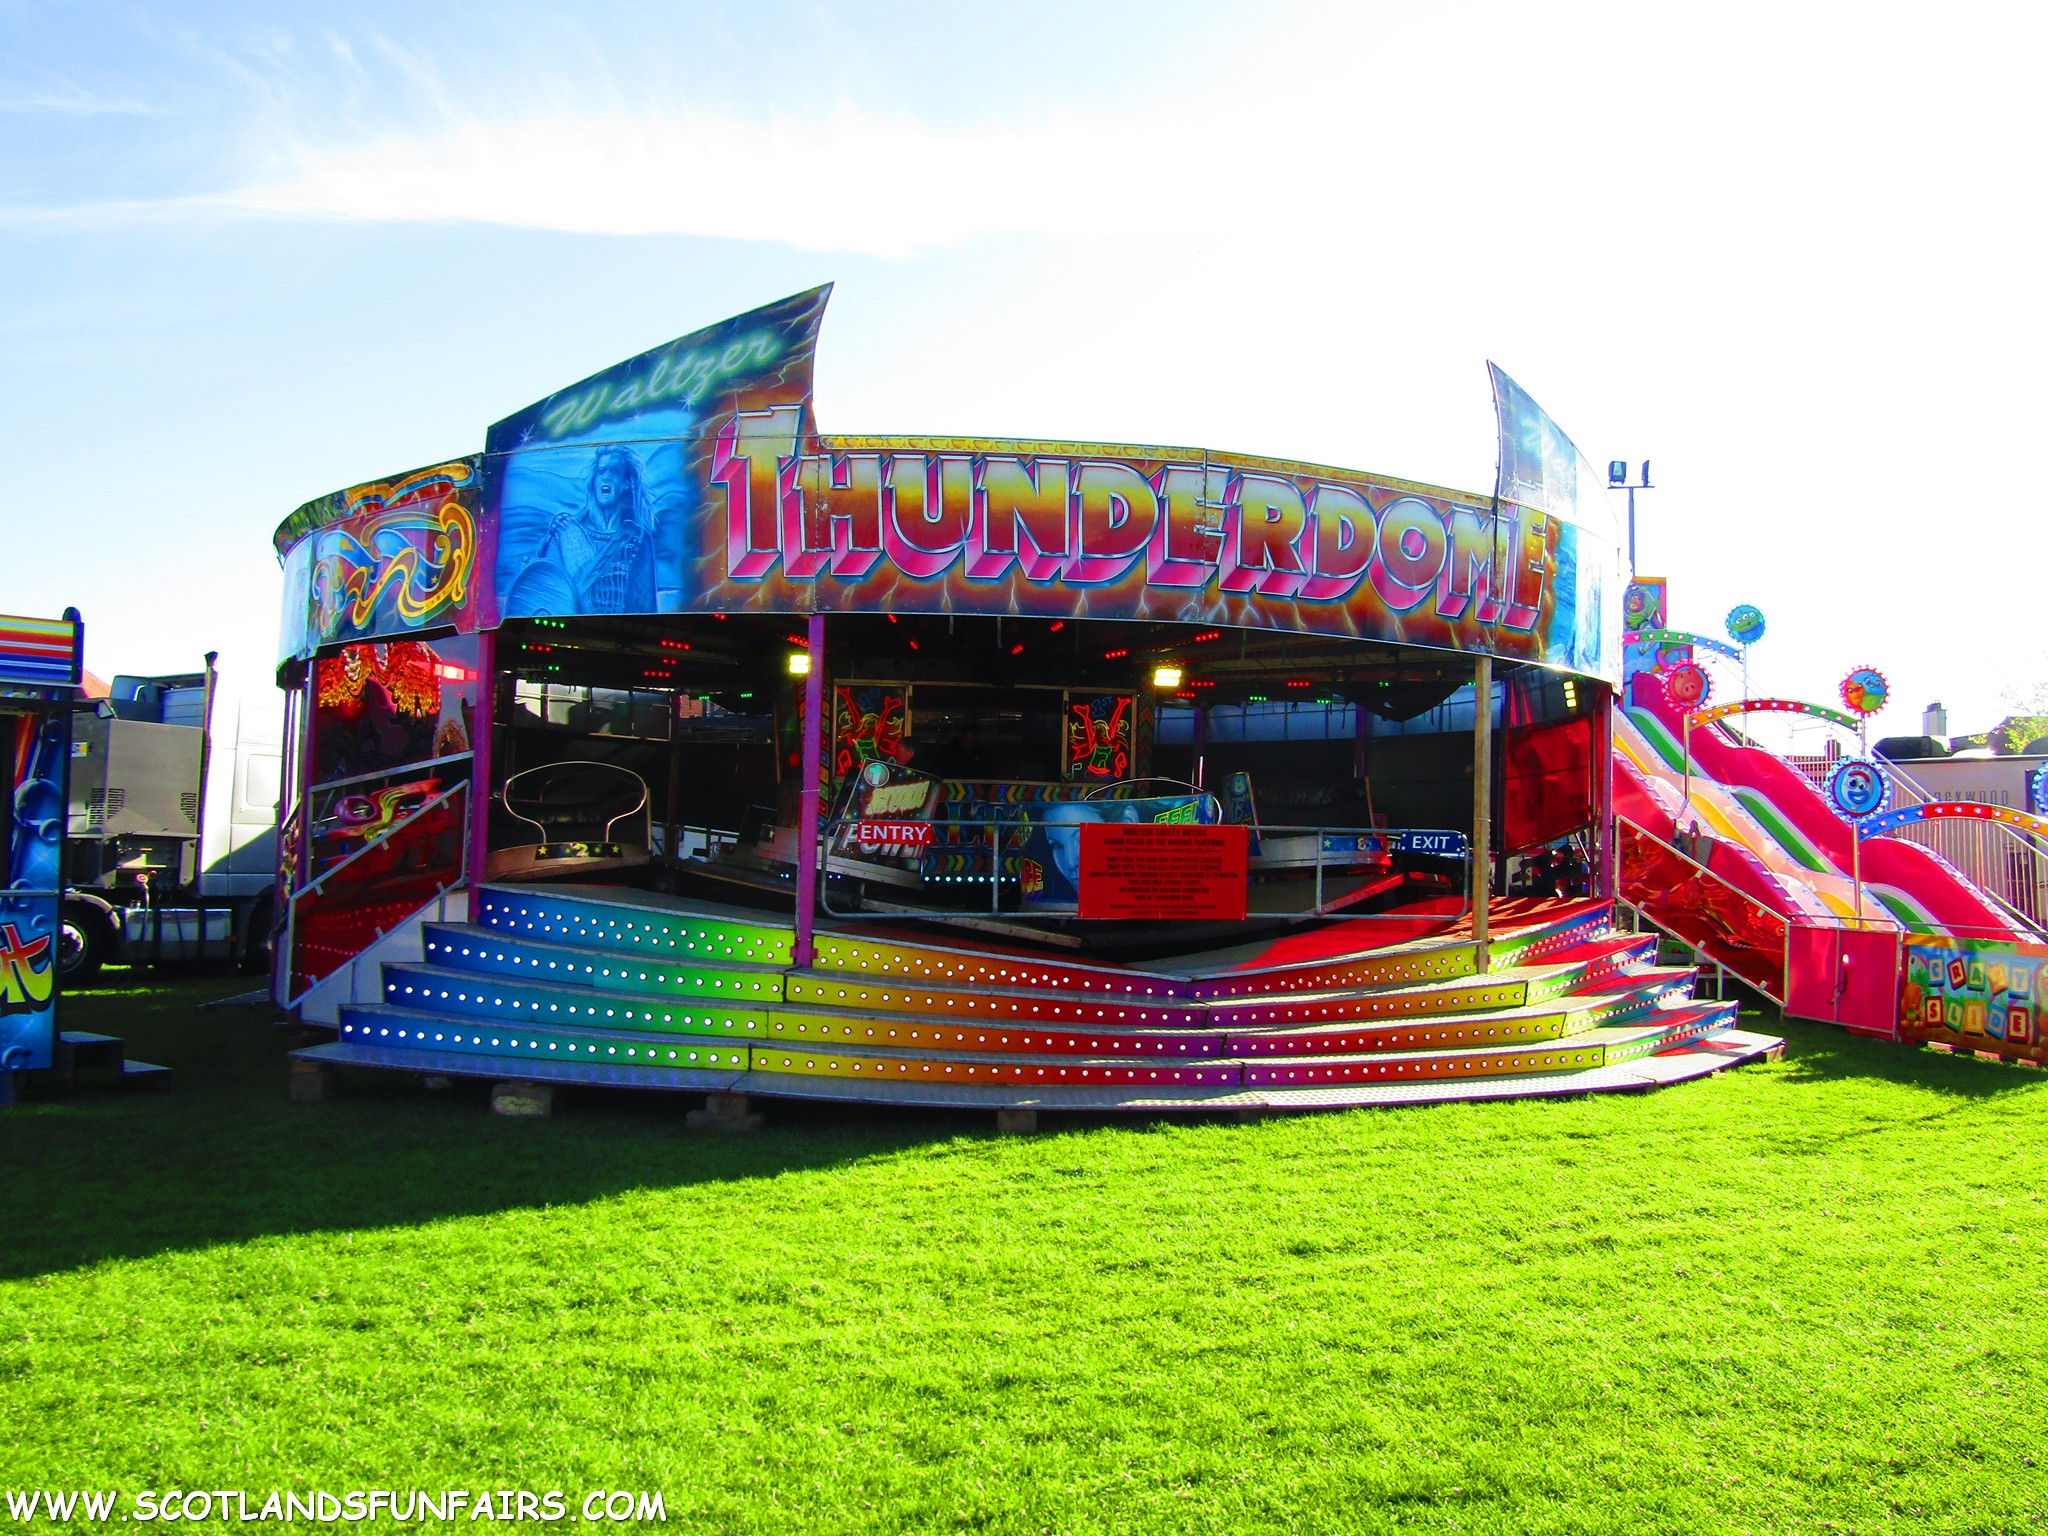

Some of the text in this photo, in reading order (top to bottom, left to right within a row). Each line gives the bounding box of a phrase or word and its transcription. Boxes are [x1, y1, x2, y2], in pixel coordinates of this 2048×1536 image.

[541, 333, 781, 438] Waltzer
[708, 403, 1549, 634] THUNDERDOME
[860, 824, 928, 840] ENTRY
[1412, 835, 1451, 849] EXIT
[1925, 996, 2030, 1042] SLIDE
